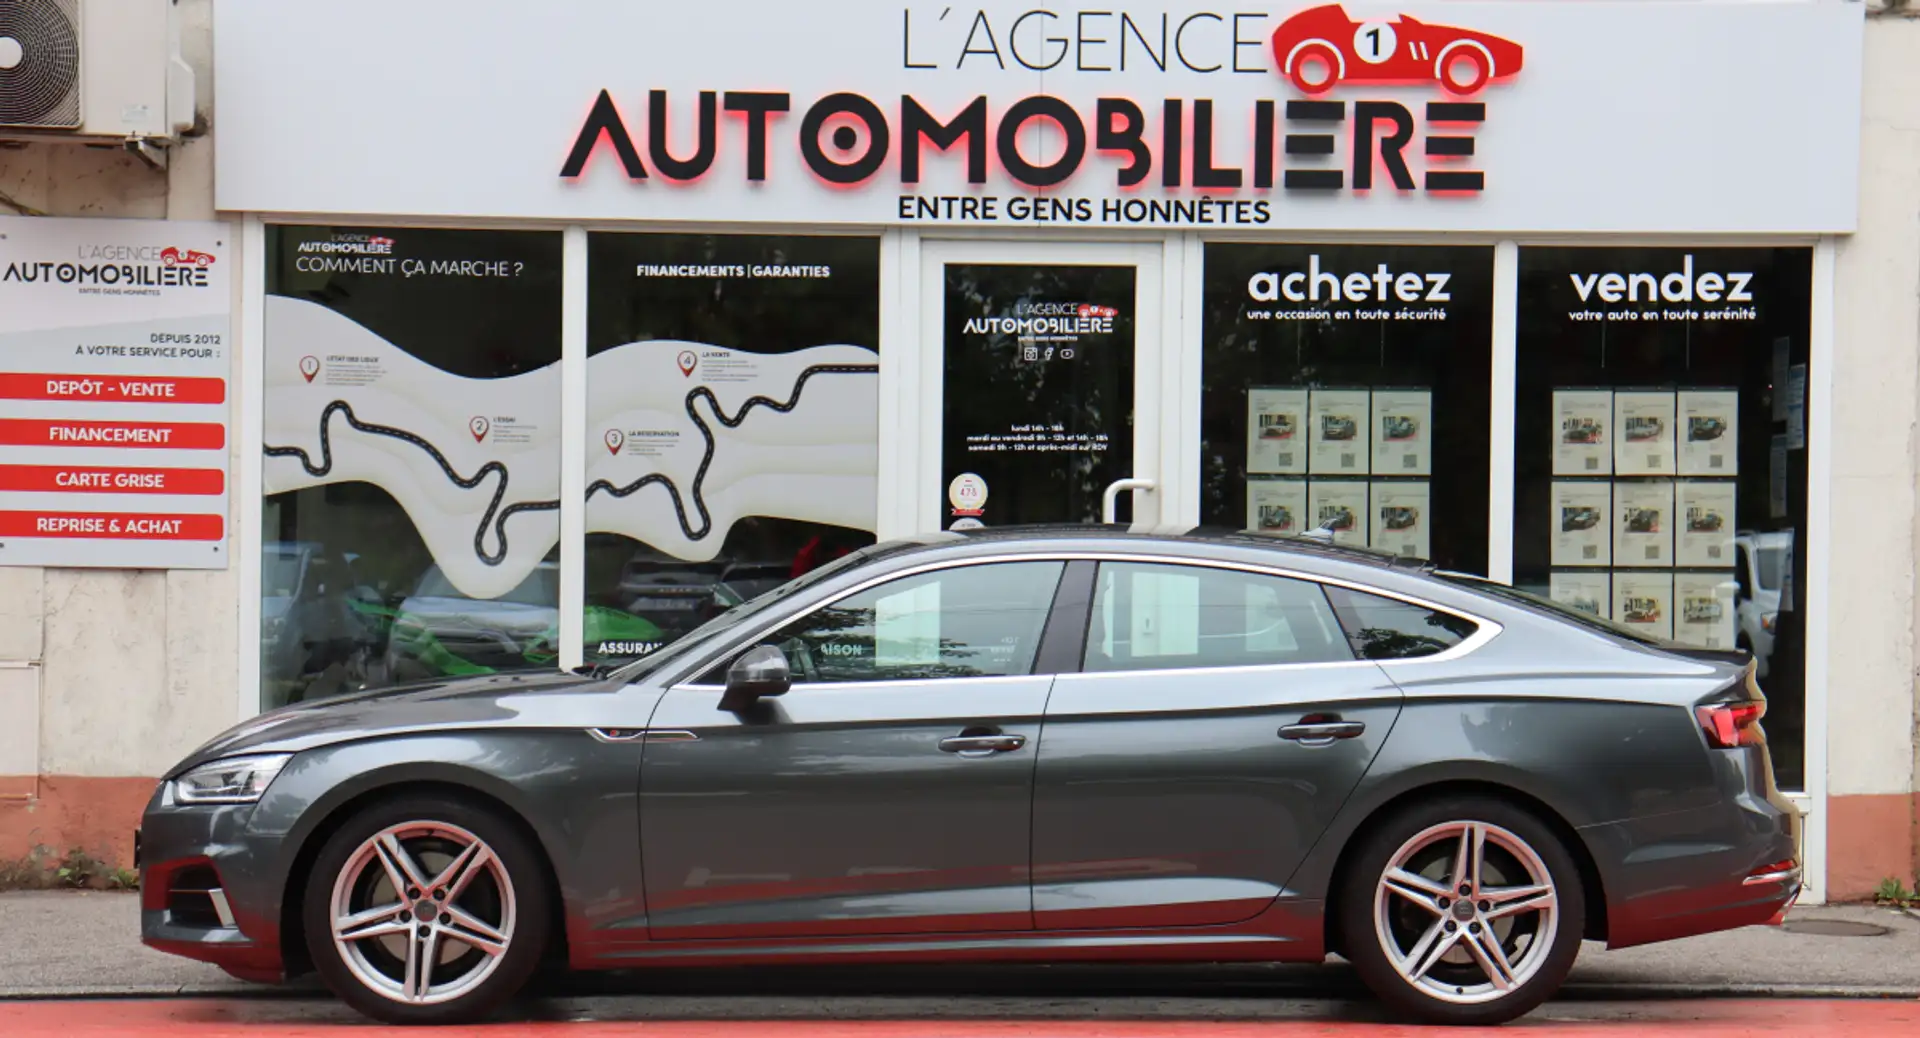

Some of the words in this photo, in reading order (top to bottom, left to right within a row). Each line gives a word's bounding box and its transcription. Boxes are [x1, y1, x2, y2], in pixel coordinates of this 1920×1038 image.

[902, 8, 1269, 73] L'AGENCE
[1365, 29, 1381, 57] 1
[559, 88, 1485, 193] AUTOMOBILIERE
[900, 195, 997, 220] ENTRE
[1006, 197, 1093, 222] GENS
[1102, 195, 1271, 223] HONNÊTES
[3, 262, 208, 287] AUTOMOBILIERE
[296, 256, 397, 273] COMMENT
[401, 259, 426, 277] ÇA
[430, 260, 509, 277] MARCHE
[513, 262, 524, 277] ?
[636, 265, 745, 277] FINANCEMENTS
[752, 265, 830, 277] GARANTIES
[1248, 254, 1452, 302] achetez
[1569, 254, 1754, 302] vendez
[1247, 309, 1271, 320] une
[1275, 307, 1331, 320] occasion
[1335, 309, 1350, 320] en
[1355, 308, 1390, 320] toute
[1394, 306, 1446, 320] sécurité
[1568, 309, 1603, 321] votre
[1607, 309, 1638, 321] auto
[1642, 310, 1659, 321] en
[1663, 309, 1699, 321] toute
[963, 318, 1114, 334] AUTOMOBILIERE
[150, 333, 192, 344] DEPUIS
[195, 334, 220, 345] 2012
[87, 346, 126, 356] VOTRE
[130, 347, 177, 357] SERVICE
[180, 349, 213, 358] POUR
[46, 379, 103, 394] DEPÔT
[119, 382, 176, 397] VENTE
[476, 420, 483, 431] 2
[49, 427, 172, 443] FINANCEMENT
[611, 433, 618, 444] 3
[55, 472, 111, 487] CARTE
[115, 474, 165, 488] GRISE
[37, 517, 105, 533] REPRISE
[109, 519, 121, 533] &
[125, 520, 182, 534] ACHAT
